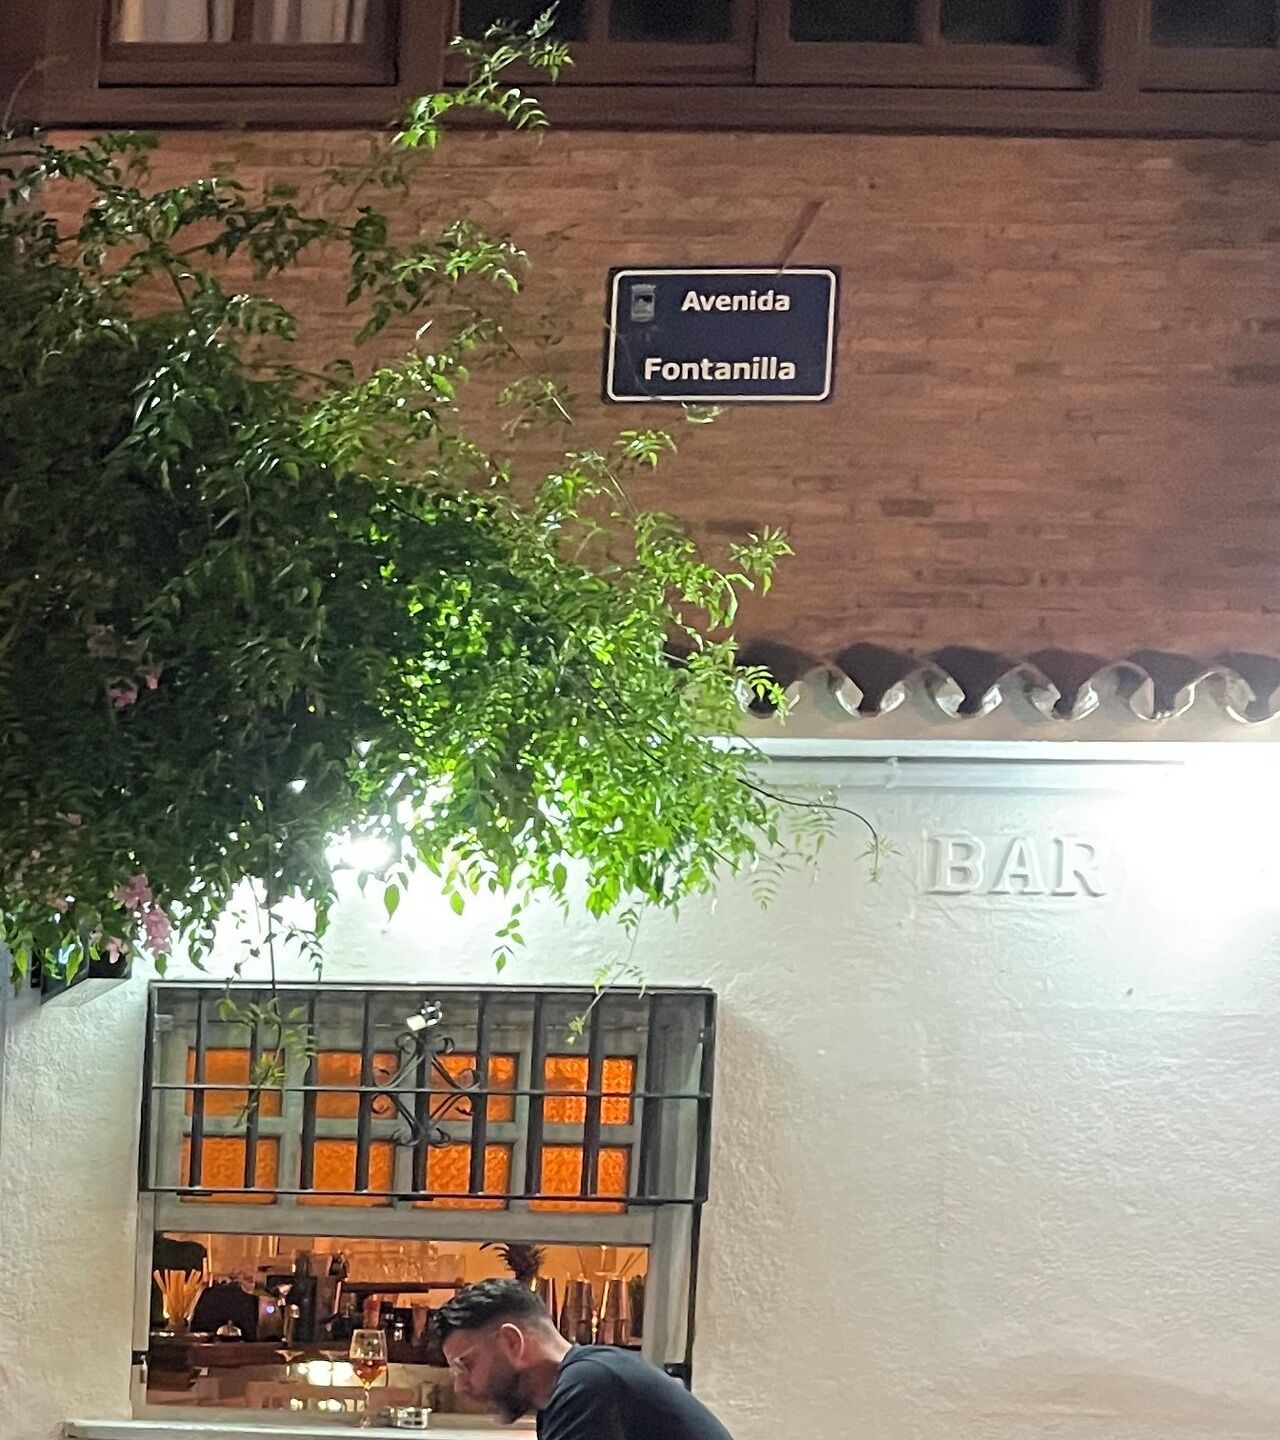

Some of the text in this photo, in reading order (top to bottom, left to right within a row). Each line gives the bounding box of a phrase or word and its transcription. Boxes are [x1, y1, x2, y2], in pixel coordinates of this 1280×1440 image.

[680, 289, 791, 312] Avenida
[644, 356, 796, 381] Fontanilla
[924, 833, 1107, 897] BAR
